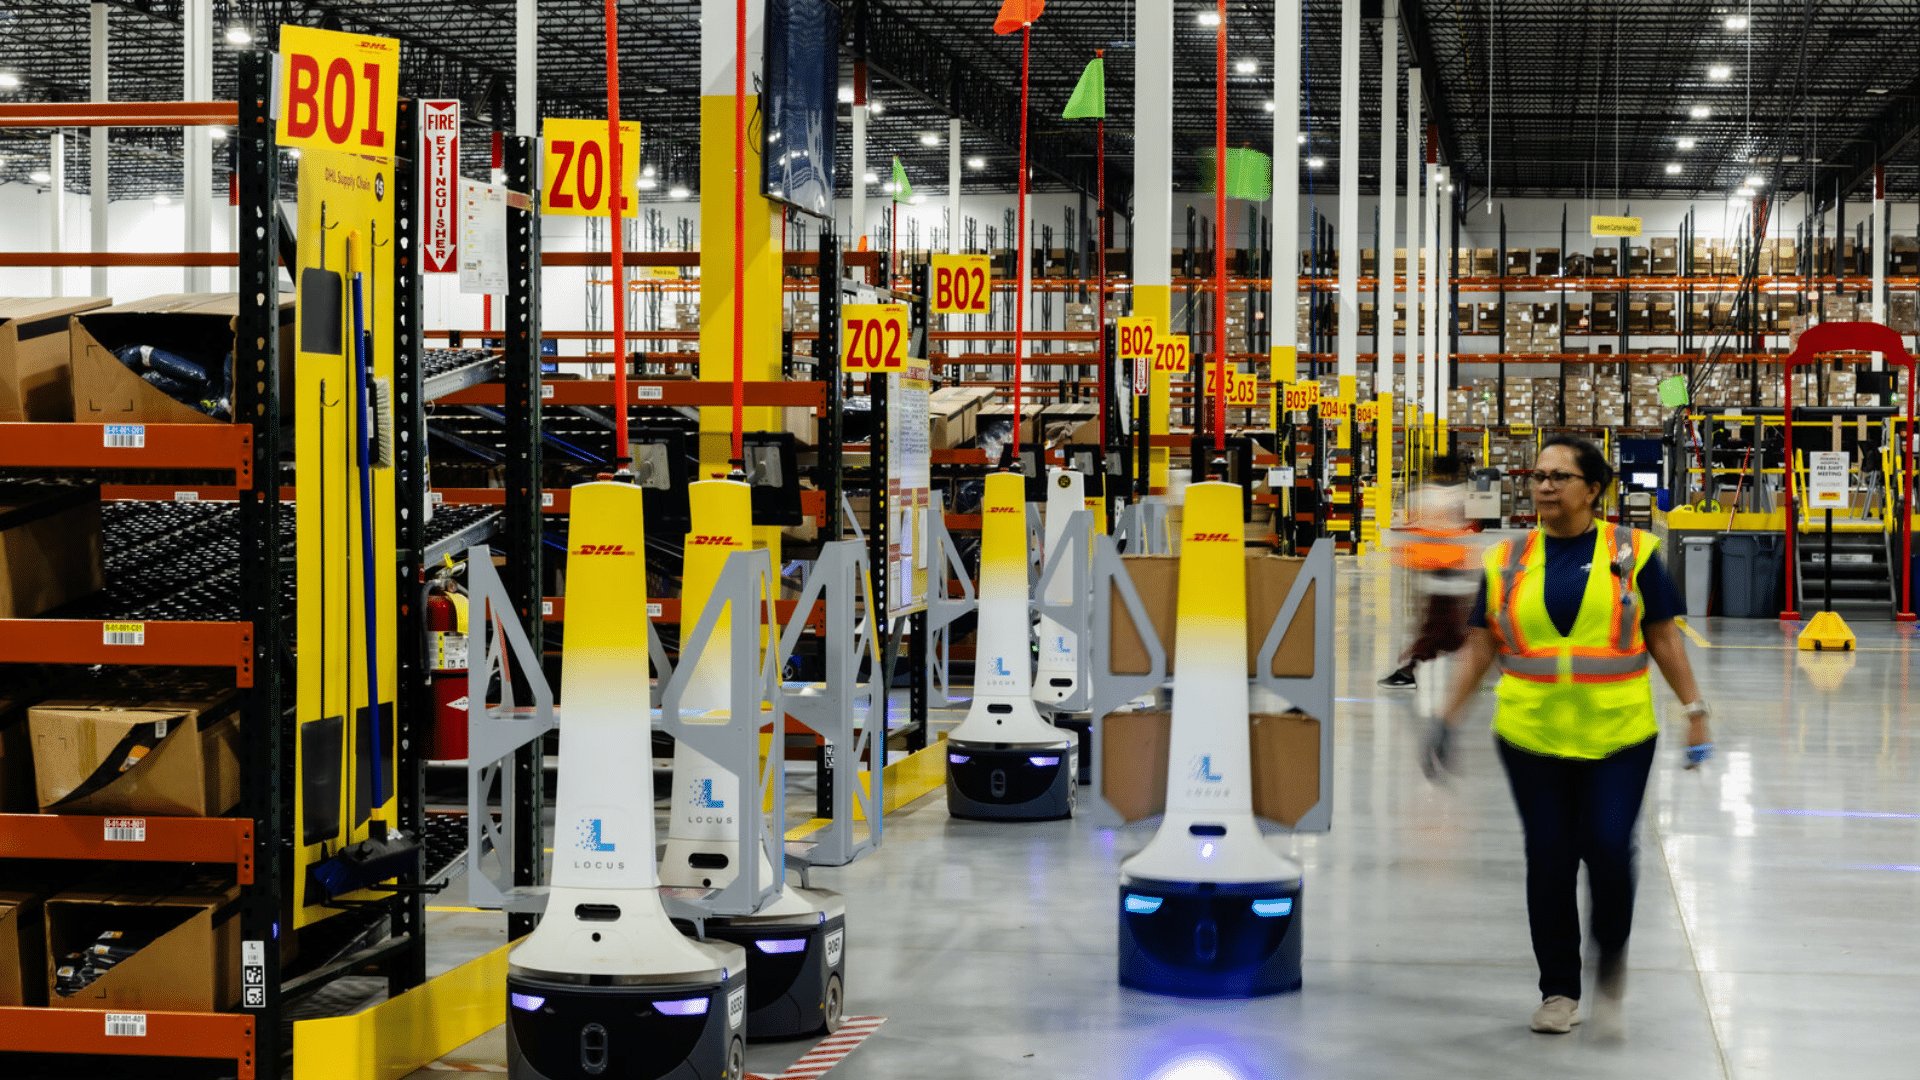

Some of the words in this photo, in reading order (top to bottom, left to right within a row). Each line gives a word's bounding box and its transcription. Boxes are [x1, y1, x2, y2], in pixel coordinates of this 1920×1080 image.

[287, 53, 385, 148] B01
[428, 114, 455, 130] FIRE
[436, 136, 447, 259] EXTINGUISHER
[937, 267, 985, 310] B02
[846, 318, 901, 367] Z02
[1121, 325, 1153, 355] B02
[1154, 343, 1186, 371] Z02
[1207, 370, 1234, 393] Z3
[1286, 390, 1307, 409] B03
[1320, 401, 1338, 417] Z04
[692, 536, 737, 546] DHL
[1191, 533, 1233, 542] DHL
[577, 545, 629, 556] DHL
[688, 816, 733, 824] LOCUS
[574, 861, 625, 870] LOCUS
